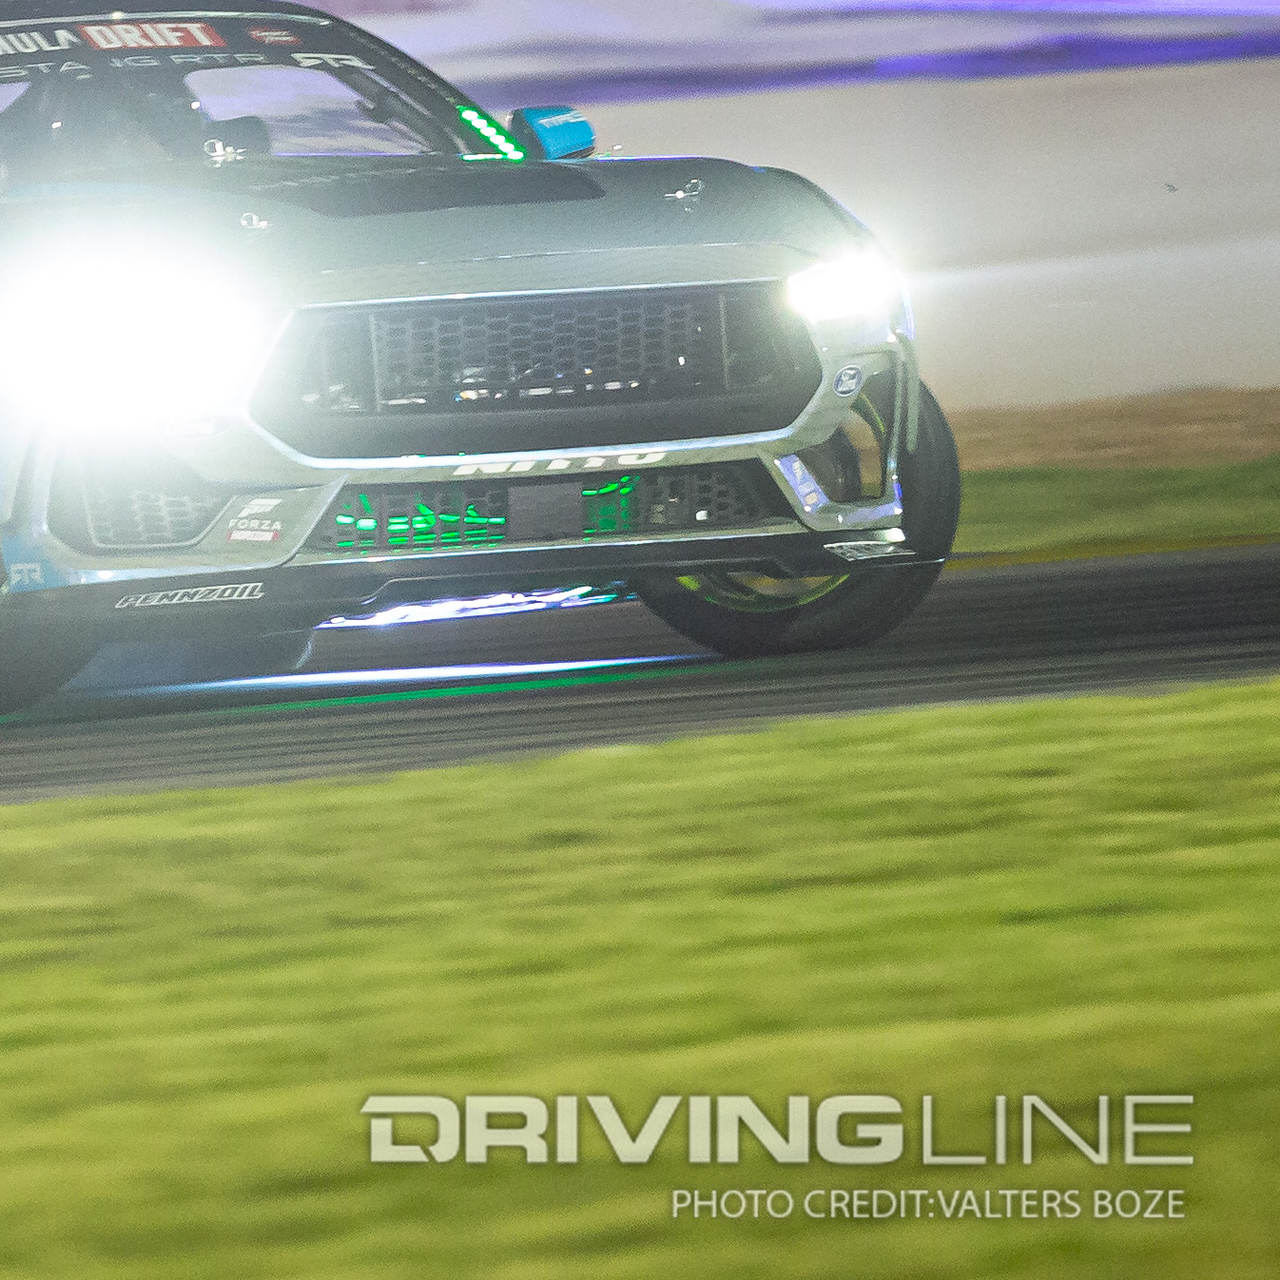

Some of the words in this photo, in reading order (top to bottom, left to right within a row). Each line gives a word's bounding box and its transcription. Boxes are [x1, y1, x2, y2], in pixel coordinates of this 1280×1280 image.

[82, 22, 212, 50] DRIFT
[227, 518, 283, 531] FORZA
[114, 582, 265, 609] PENNZOIL
